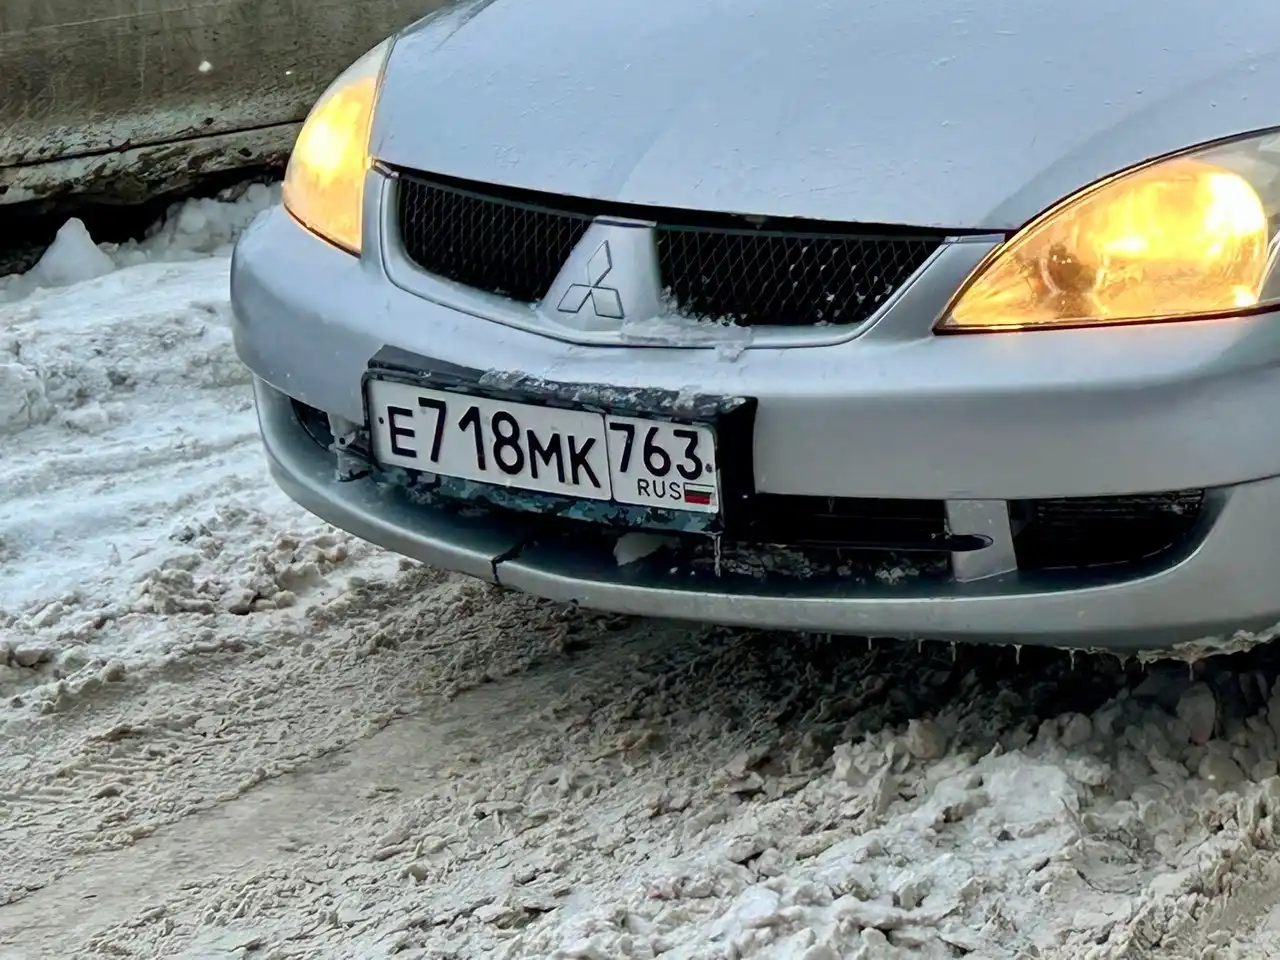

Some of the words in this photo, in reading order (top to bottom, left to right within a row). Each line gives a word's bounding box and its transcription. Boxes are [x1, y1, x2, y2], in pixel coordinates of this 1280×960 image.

[387, 397, 602, 489] E718MK
[609, 422, 703, 481] 763
[637, 478, 682, 500] RUS
